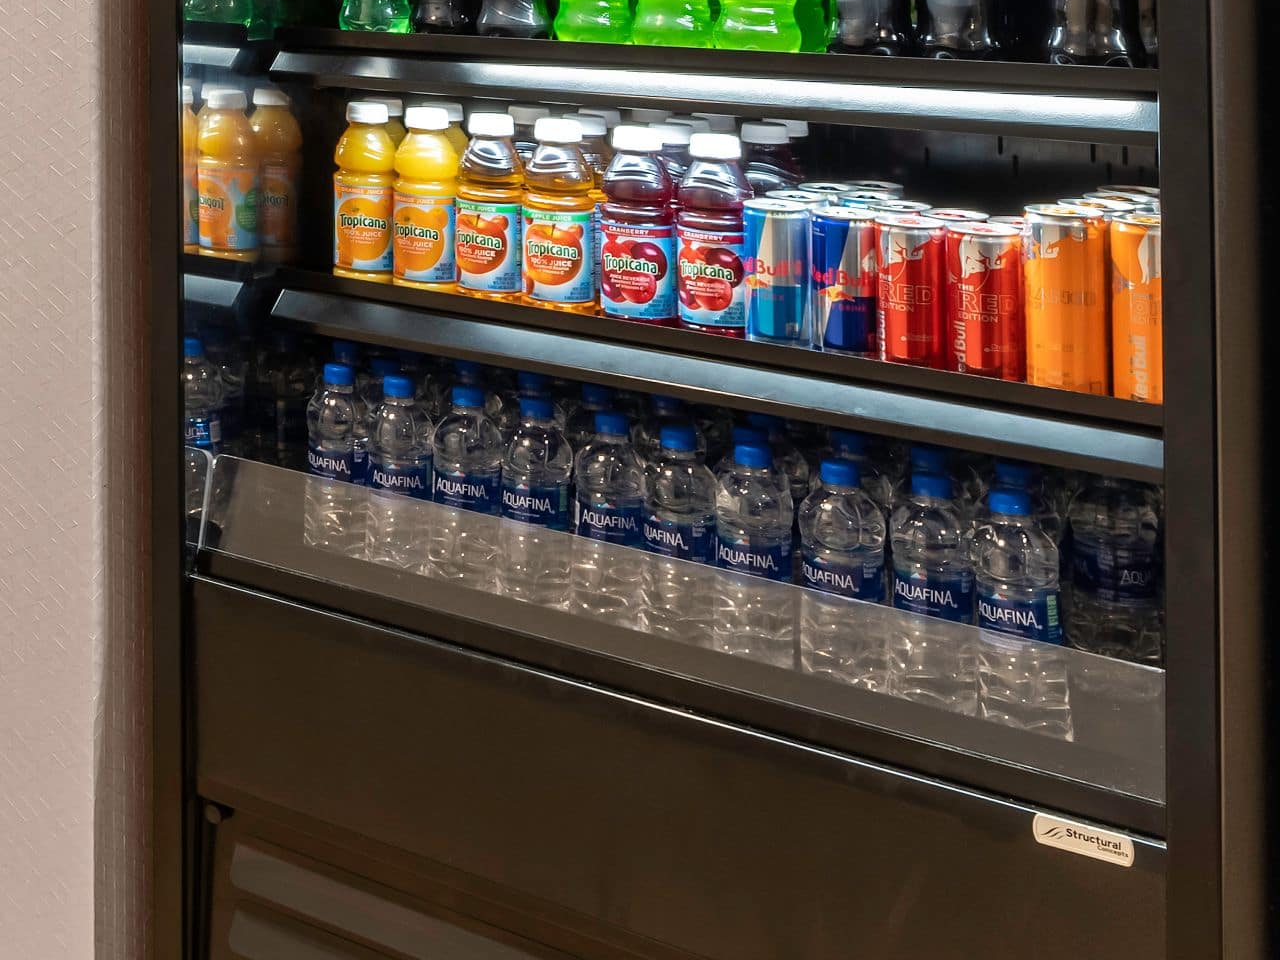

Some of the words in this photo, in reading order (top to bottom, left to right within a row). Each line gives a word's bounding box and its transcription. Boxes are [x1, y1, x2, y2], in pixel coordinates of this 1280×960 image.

[340, 213, 386, 230] Tropicana
[394, 222, 438, 240] Tropicana
[608, 226, 649, 235] CRANBERRY
[457, 229, 501, 249] Tropicana
[683, 231, 723, 240] CRANBERRY
[528, 239, 578, 260] Tropicana
[605, 254, 658, 274] Tropicana
[681, 259, 732, 281] Tropicana
[958, 283, 974, 291] THE
[958, 291, 1016, 315] RED
[373, 470, 420, 489] AQUAFINA
[436, 476, 485, 498] AQUAFINA
[503, 490, 551, 511] AQUAFINA
[582, 510, 636, 531] AQUAFINA
[719, 545, 775, 569] AQUAFINA
[894, 578, 953, 607] AQUAFINA
[978, 599, 1038, 626] AQUAFINA
[1066, 829, 1122, 850] Structural
[1097, 845, 1129, 858] Concepts
